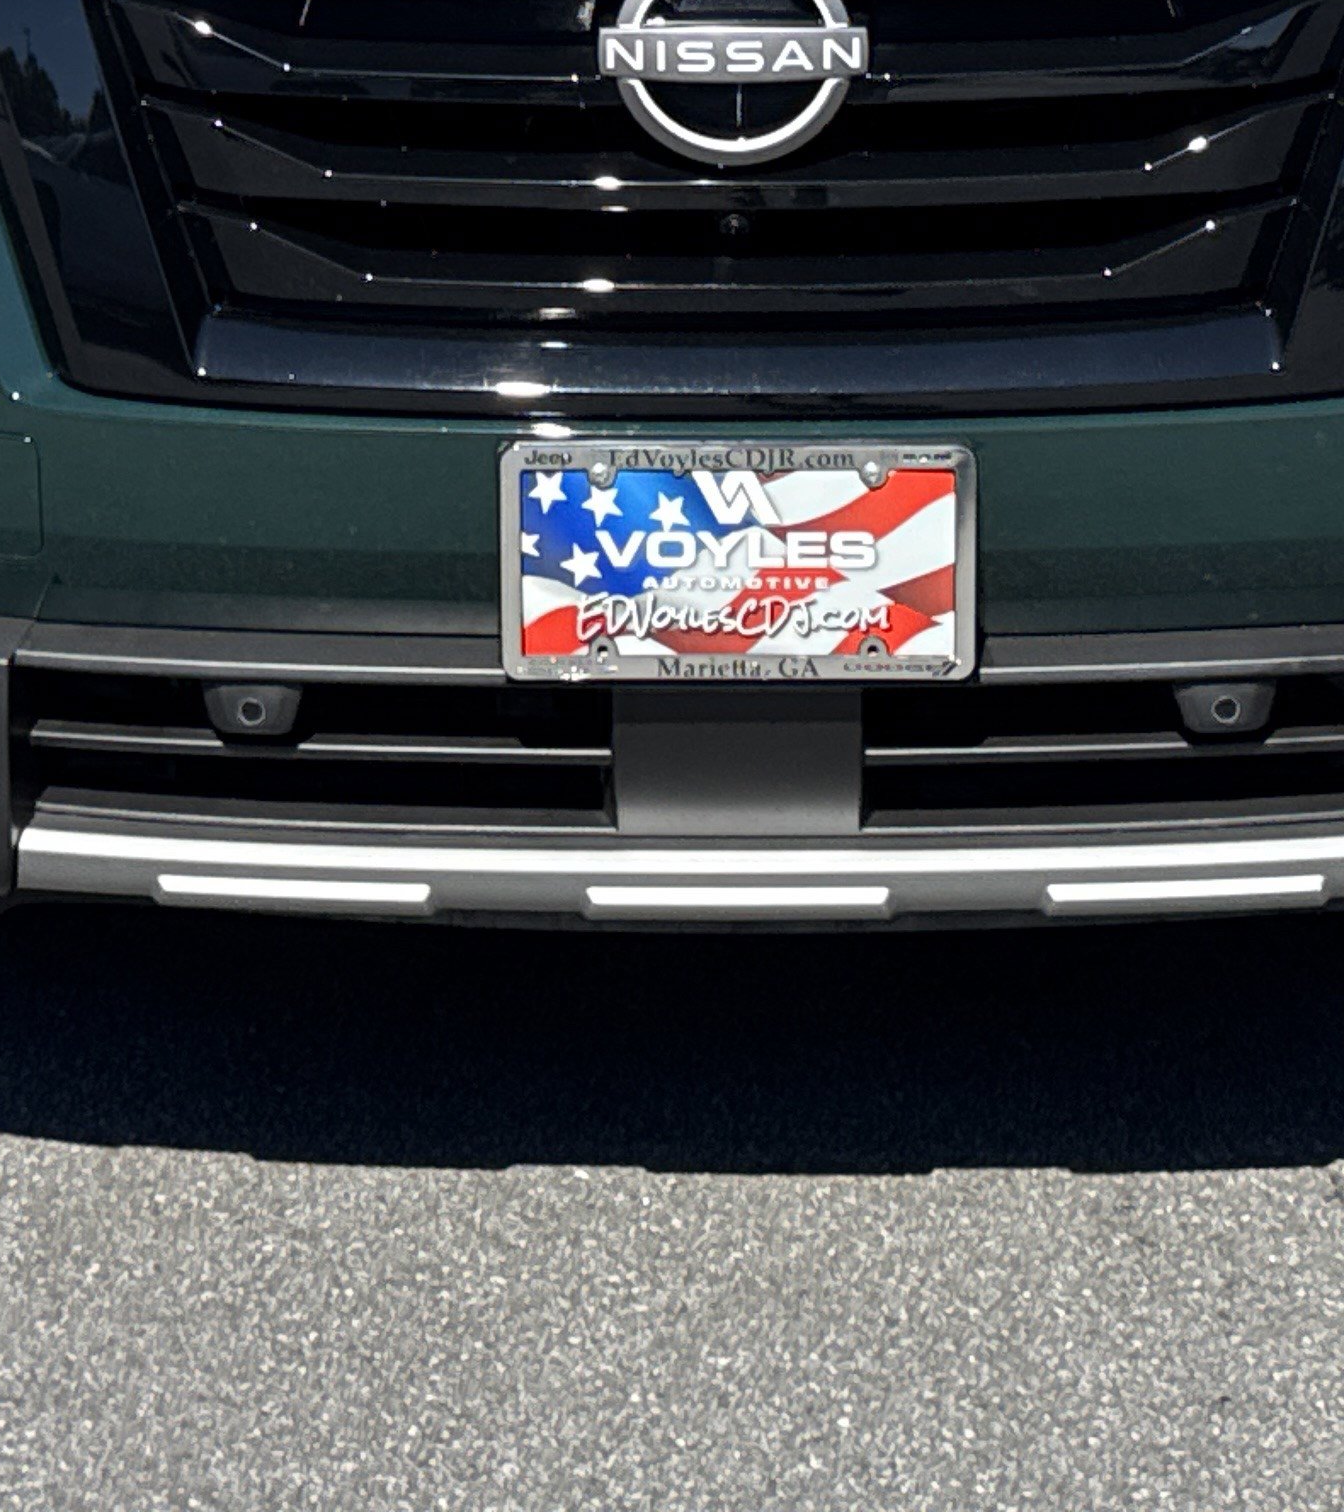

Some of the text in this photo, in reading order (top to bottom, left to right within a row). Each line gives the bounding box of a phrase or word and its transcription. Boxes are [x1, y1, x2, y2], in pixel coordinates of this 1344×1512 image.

[606, 37, 861, 72] NISSAN
[524, 450, 572, 466] Jeep
[609, 448, 855, 470] EdVoylesCDJR.com
[595, 530, 877, 569] VOYLES
[641, 576, 831, 590] AUTOMOTIVE
[657, 656, 820, 678] Marietta, GA
